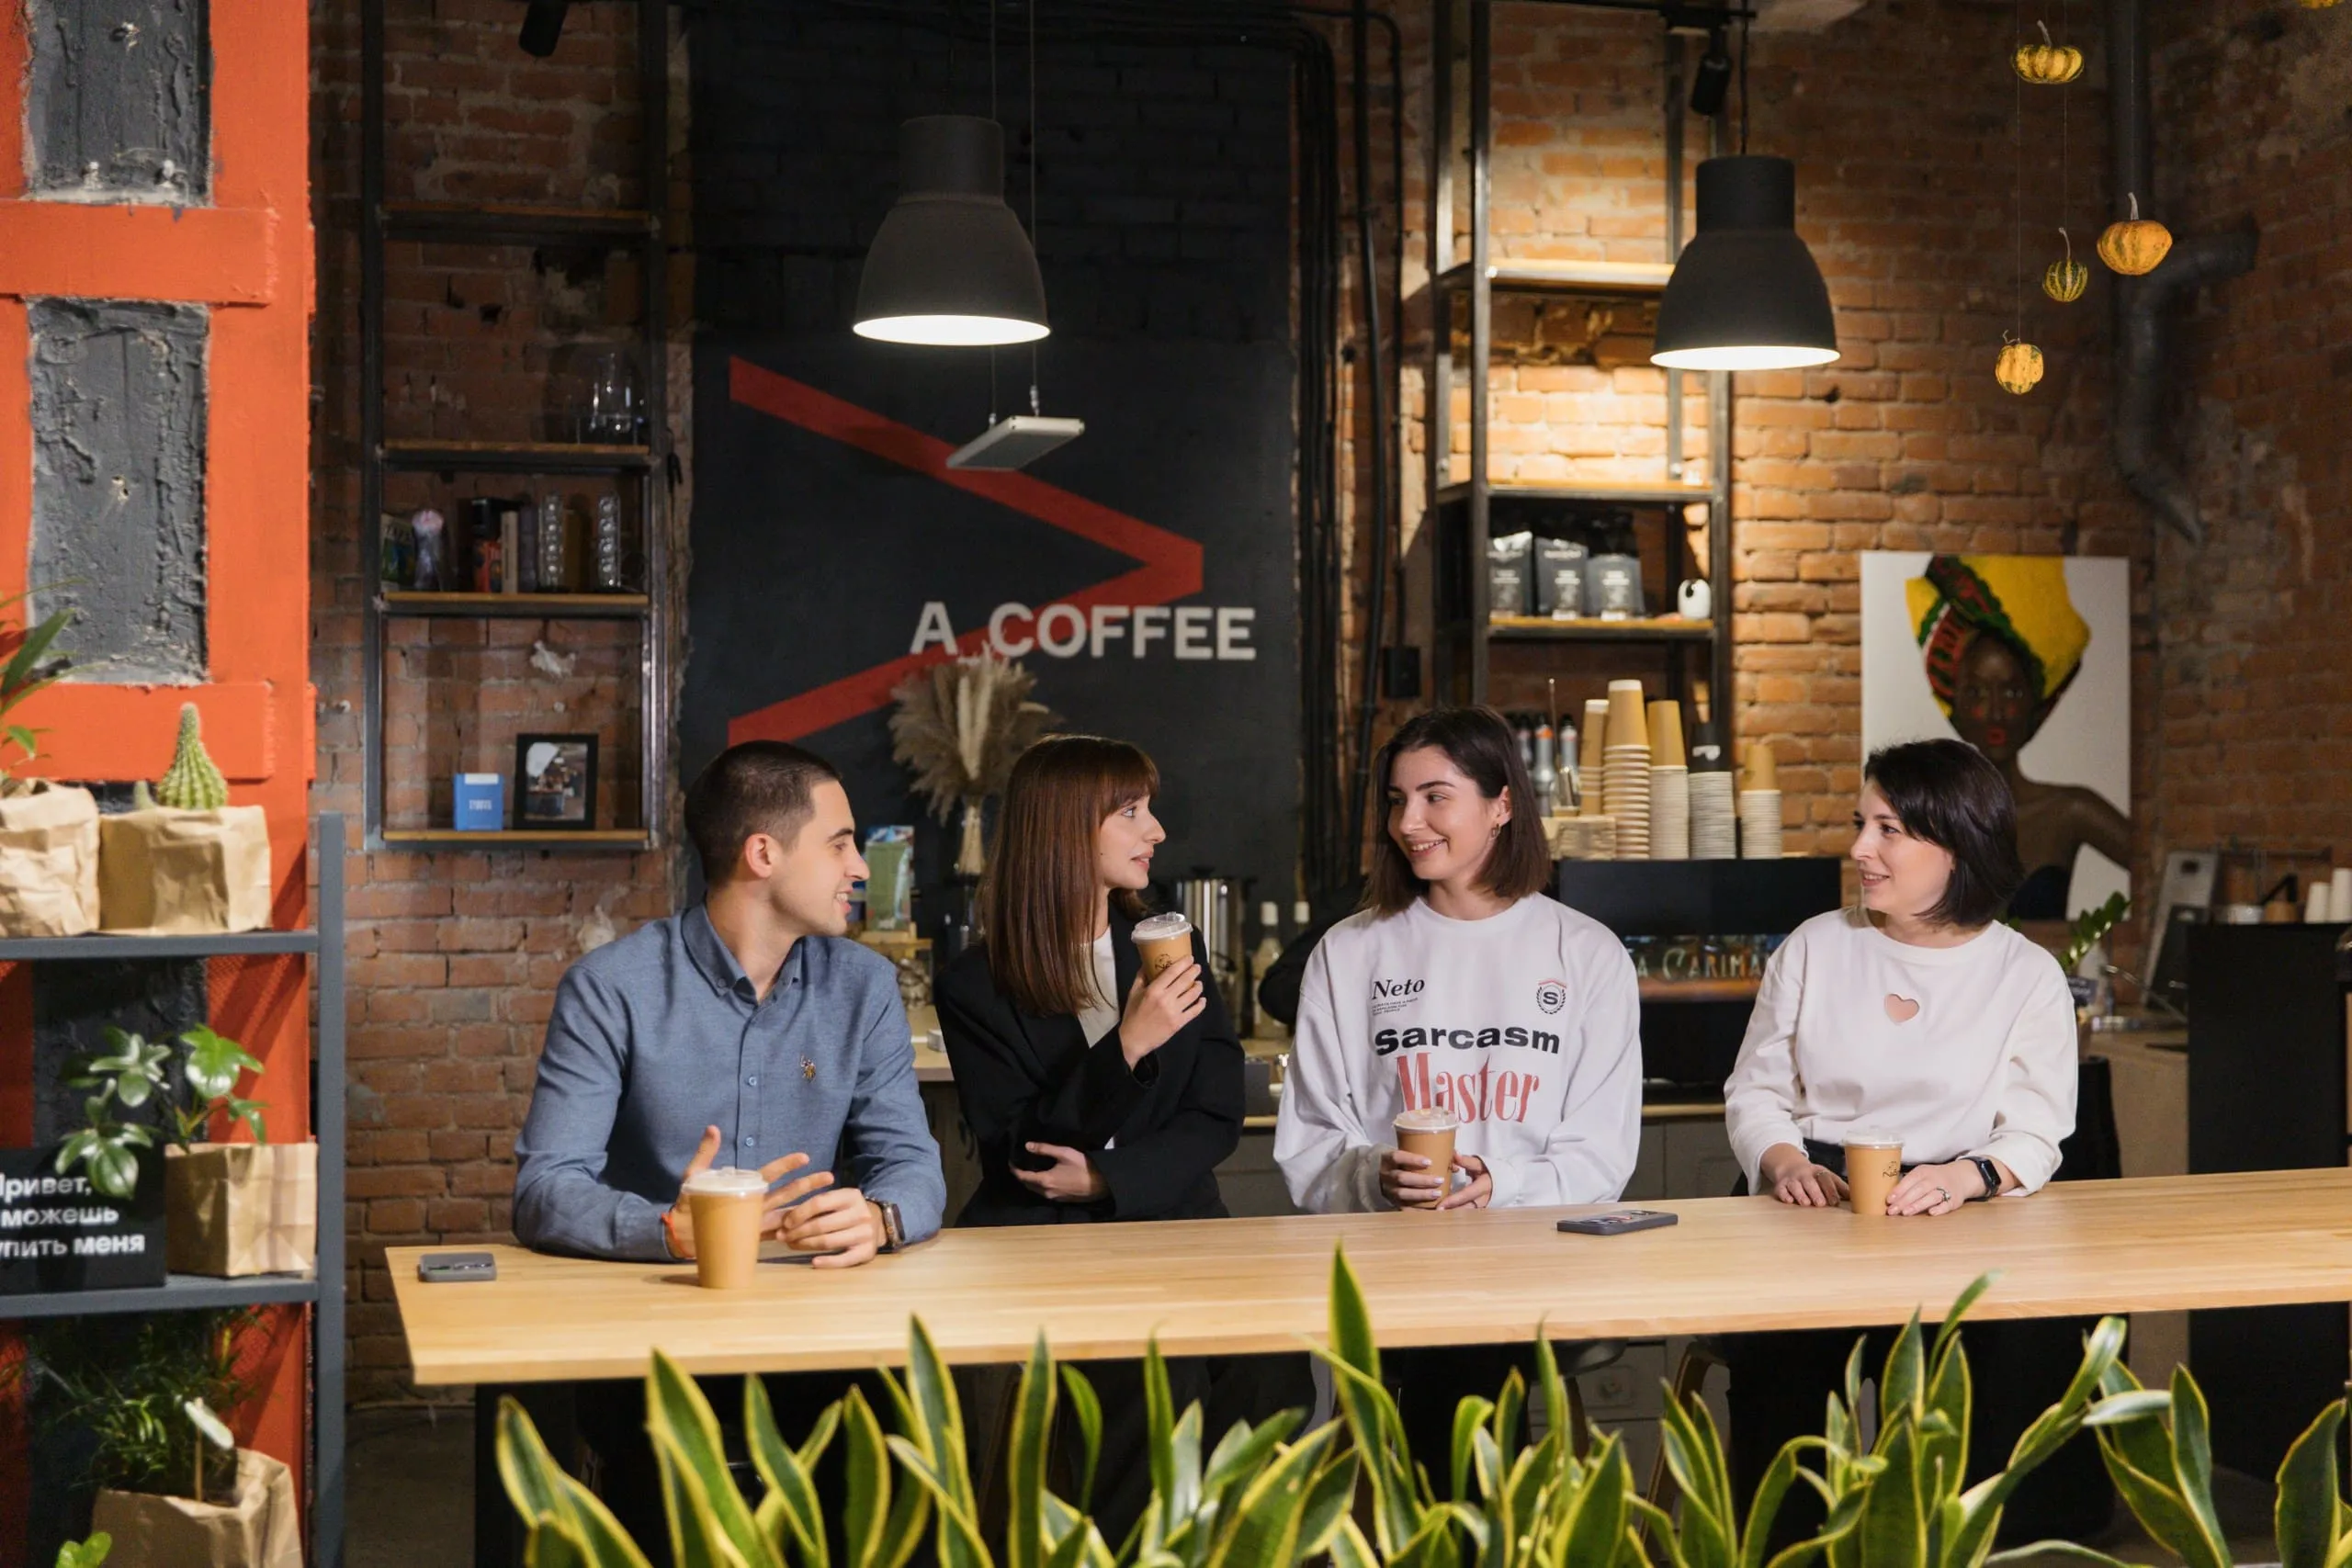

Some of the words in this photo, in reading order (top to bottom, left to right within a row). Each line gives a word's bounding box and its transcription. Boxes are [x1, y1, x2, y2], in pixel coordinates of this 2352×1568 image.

[910, 602, 958, 656] A
[989, 602, 1257, 660] COFFEE
[1662, 947, 1770, 980] CARIMA
[1371, 978, 1426, 1000] Neto
[1543, 991, 1559, 1005] S
[1374, 1026, 1560, 1055] sarcasm
[1396, 1052, 1540, 1123] Master
[1, 1207, 119, 1228] можешь
[74, 1235, 146, 1256] меня
